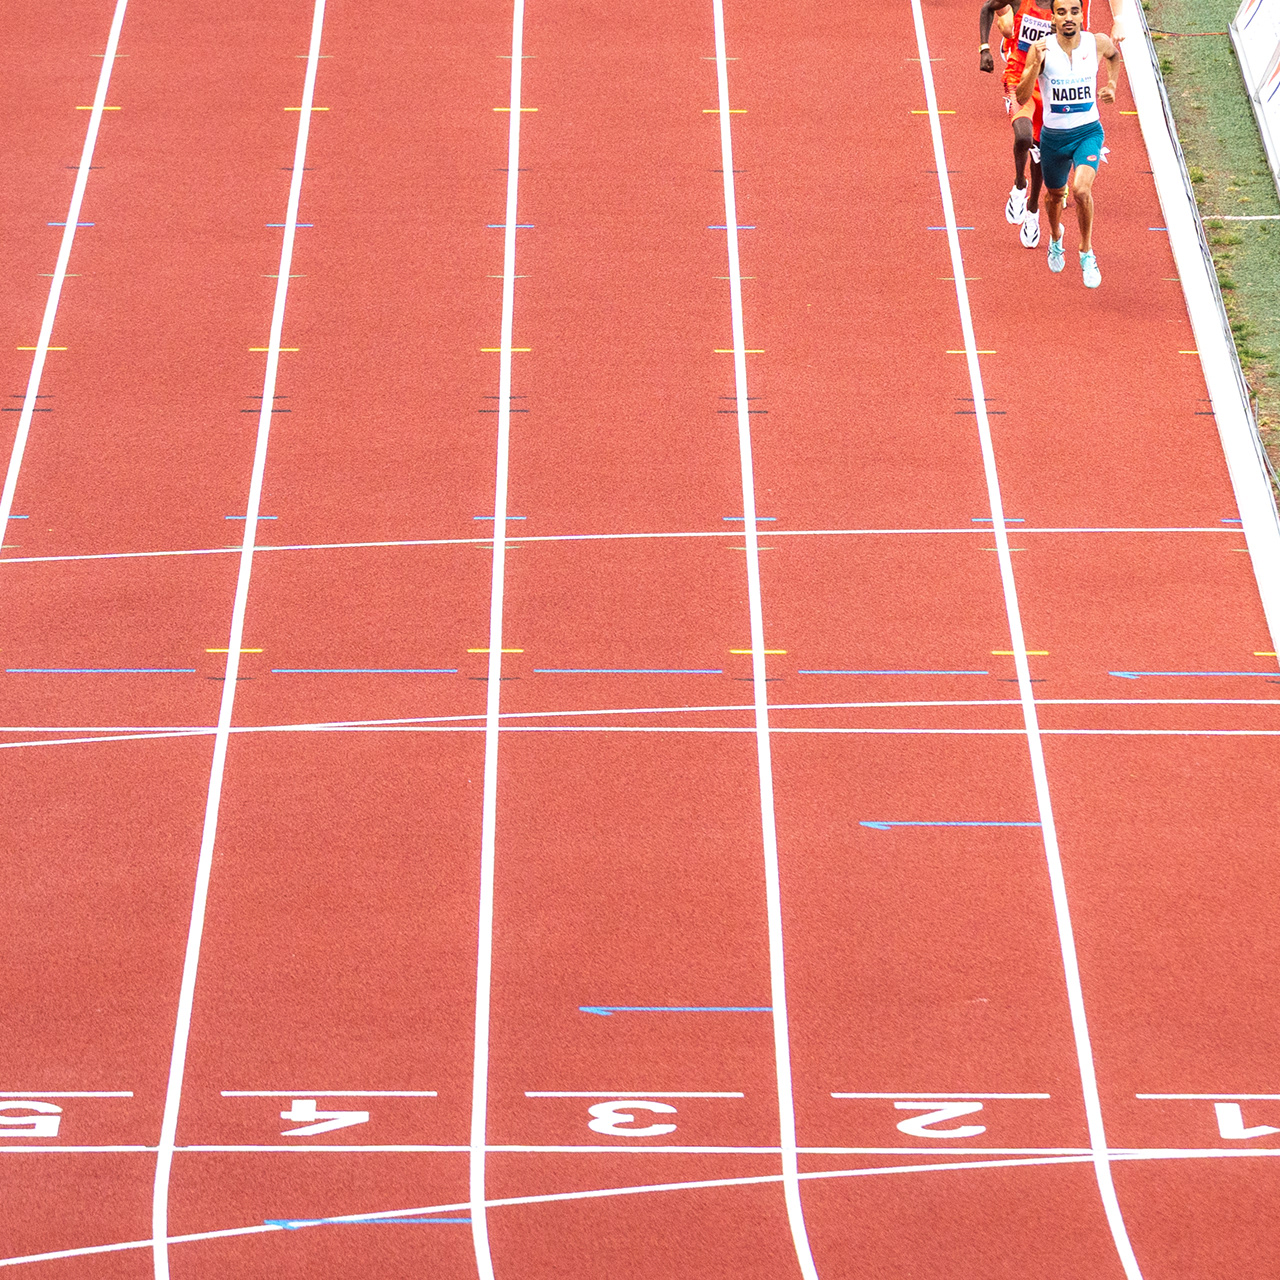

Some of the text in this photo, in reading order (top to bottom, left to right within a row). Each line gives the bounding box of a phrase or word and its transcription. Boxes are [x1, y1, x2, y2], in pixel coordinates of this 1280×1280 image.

[1052, 85, 1092, 101] NADER
[280, 1099, 370, 1136] 4
[587, 1100, 677, 1136] 3
[894, 1101, 987, 1138] 2
